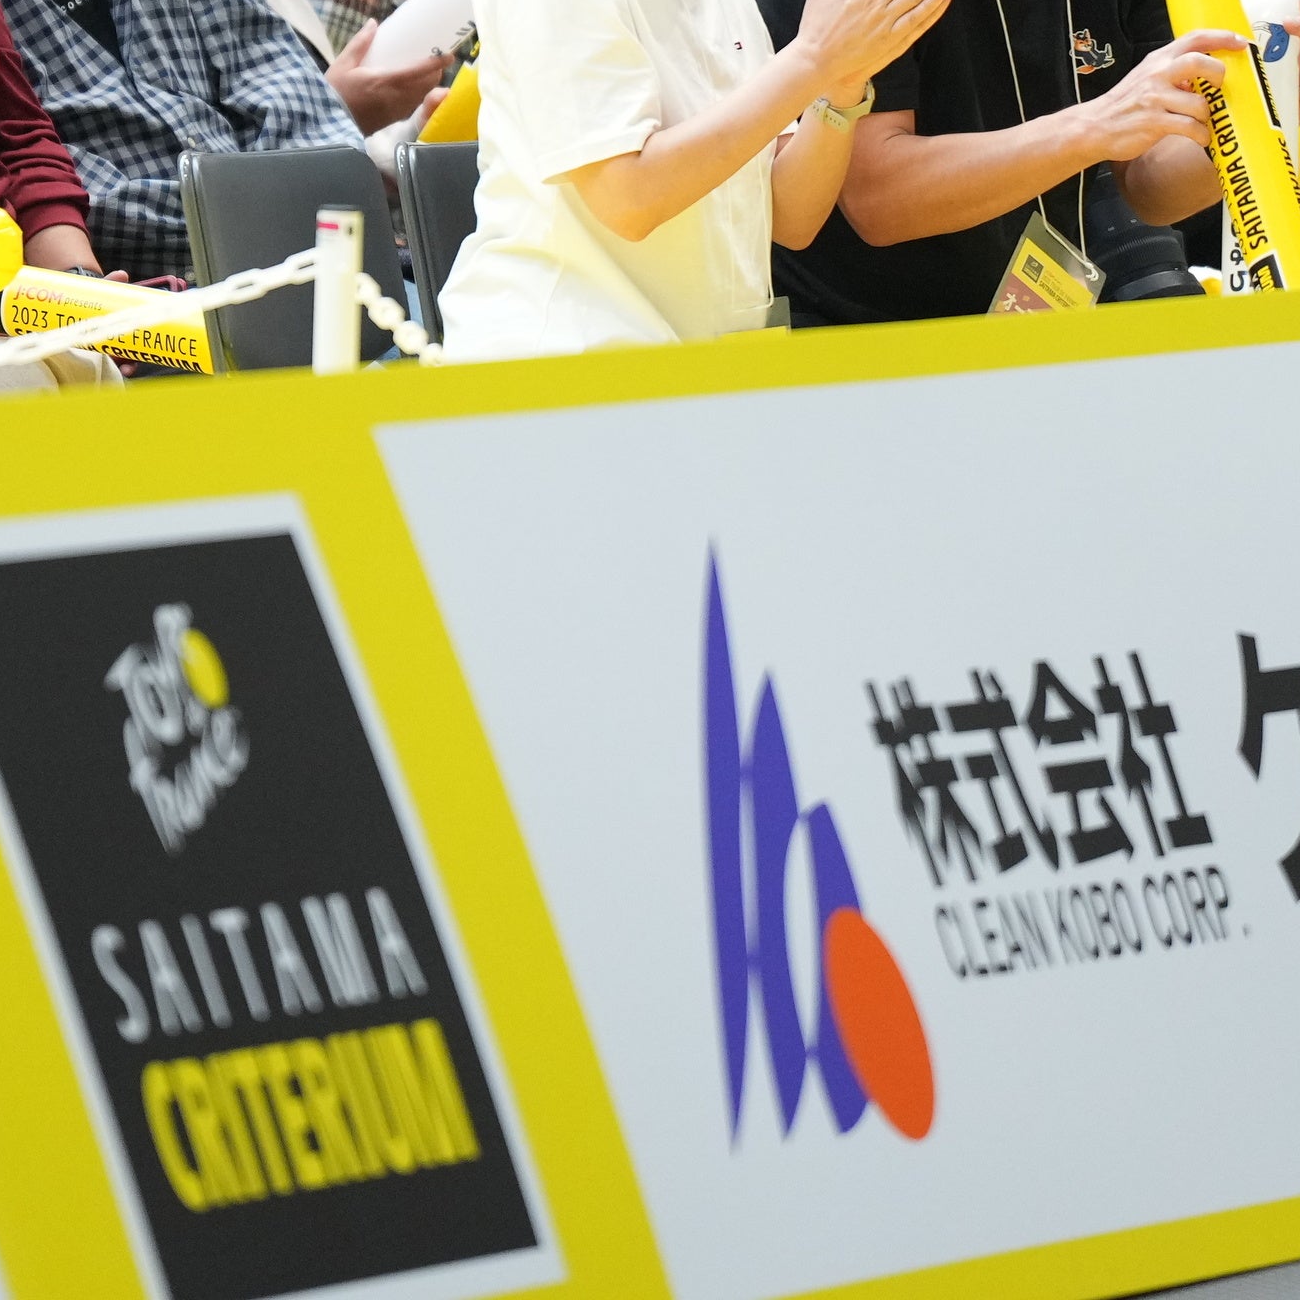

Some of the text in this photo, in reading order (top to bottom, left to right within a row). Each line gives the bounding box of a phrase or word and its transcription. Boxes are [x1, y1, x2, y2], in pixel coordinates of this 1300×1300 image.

[1226, 155, 1268, 250] SAITAMA
[12, 304, 48, 329] 2023
[132, 329, 197, 357] FRANCE
[13, 285, 103, 312] J:COM presents
[864, 647, 1215, 887] 株式会社
[90, 886, 429, 1044] SAITAMA
[933, 865, 1253, 980] CLEAN KOBO CORP.
[141, 1017, 482, 1213] CRITERIUM
